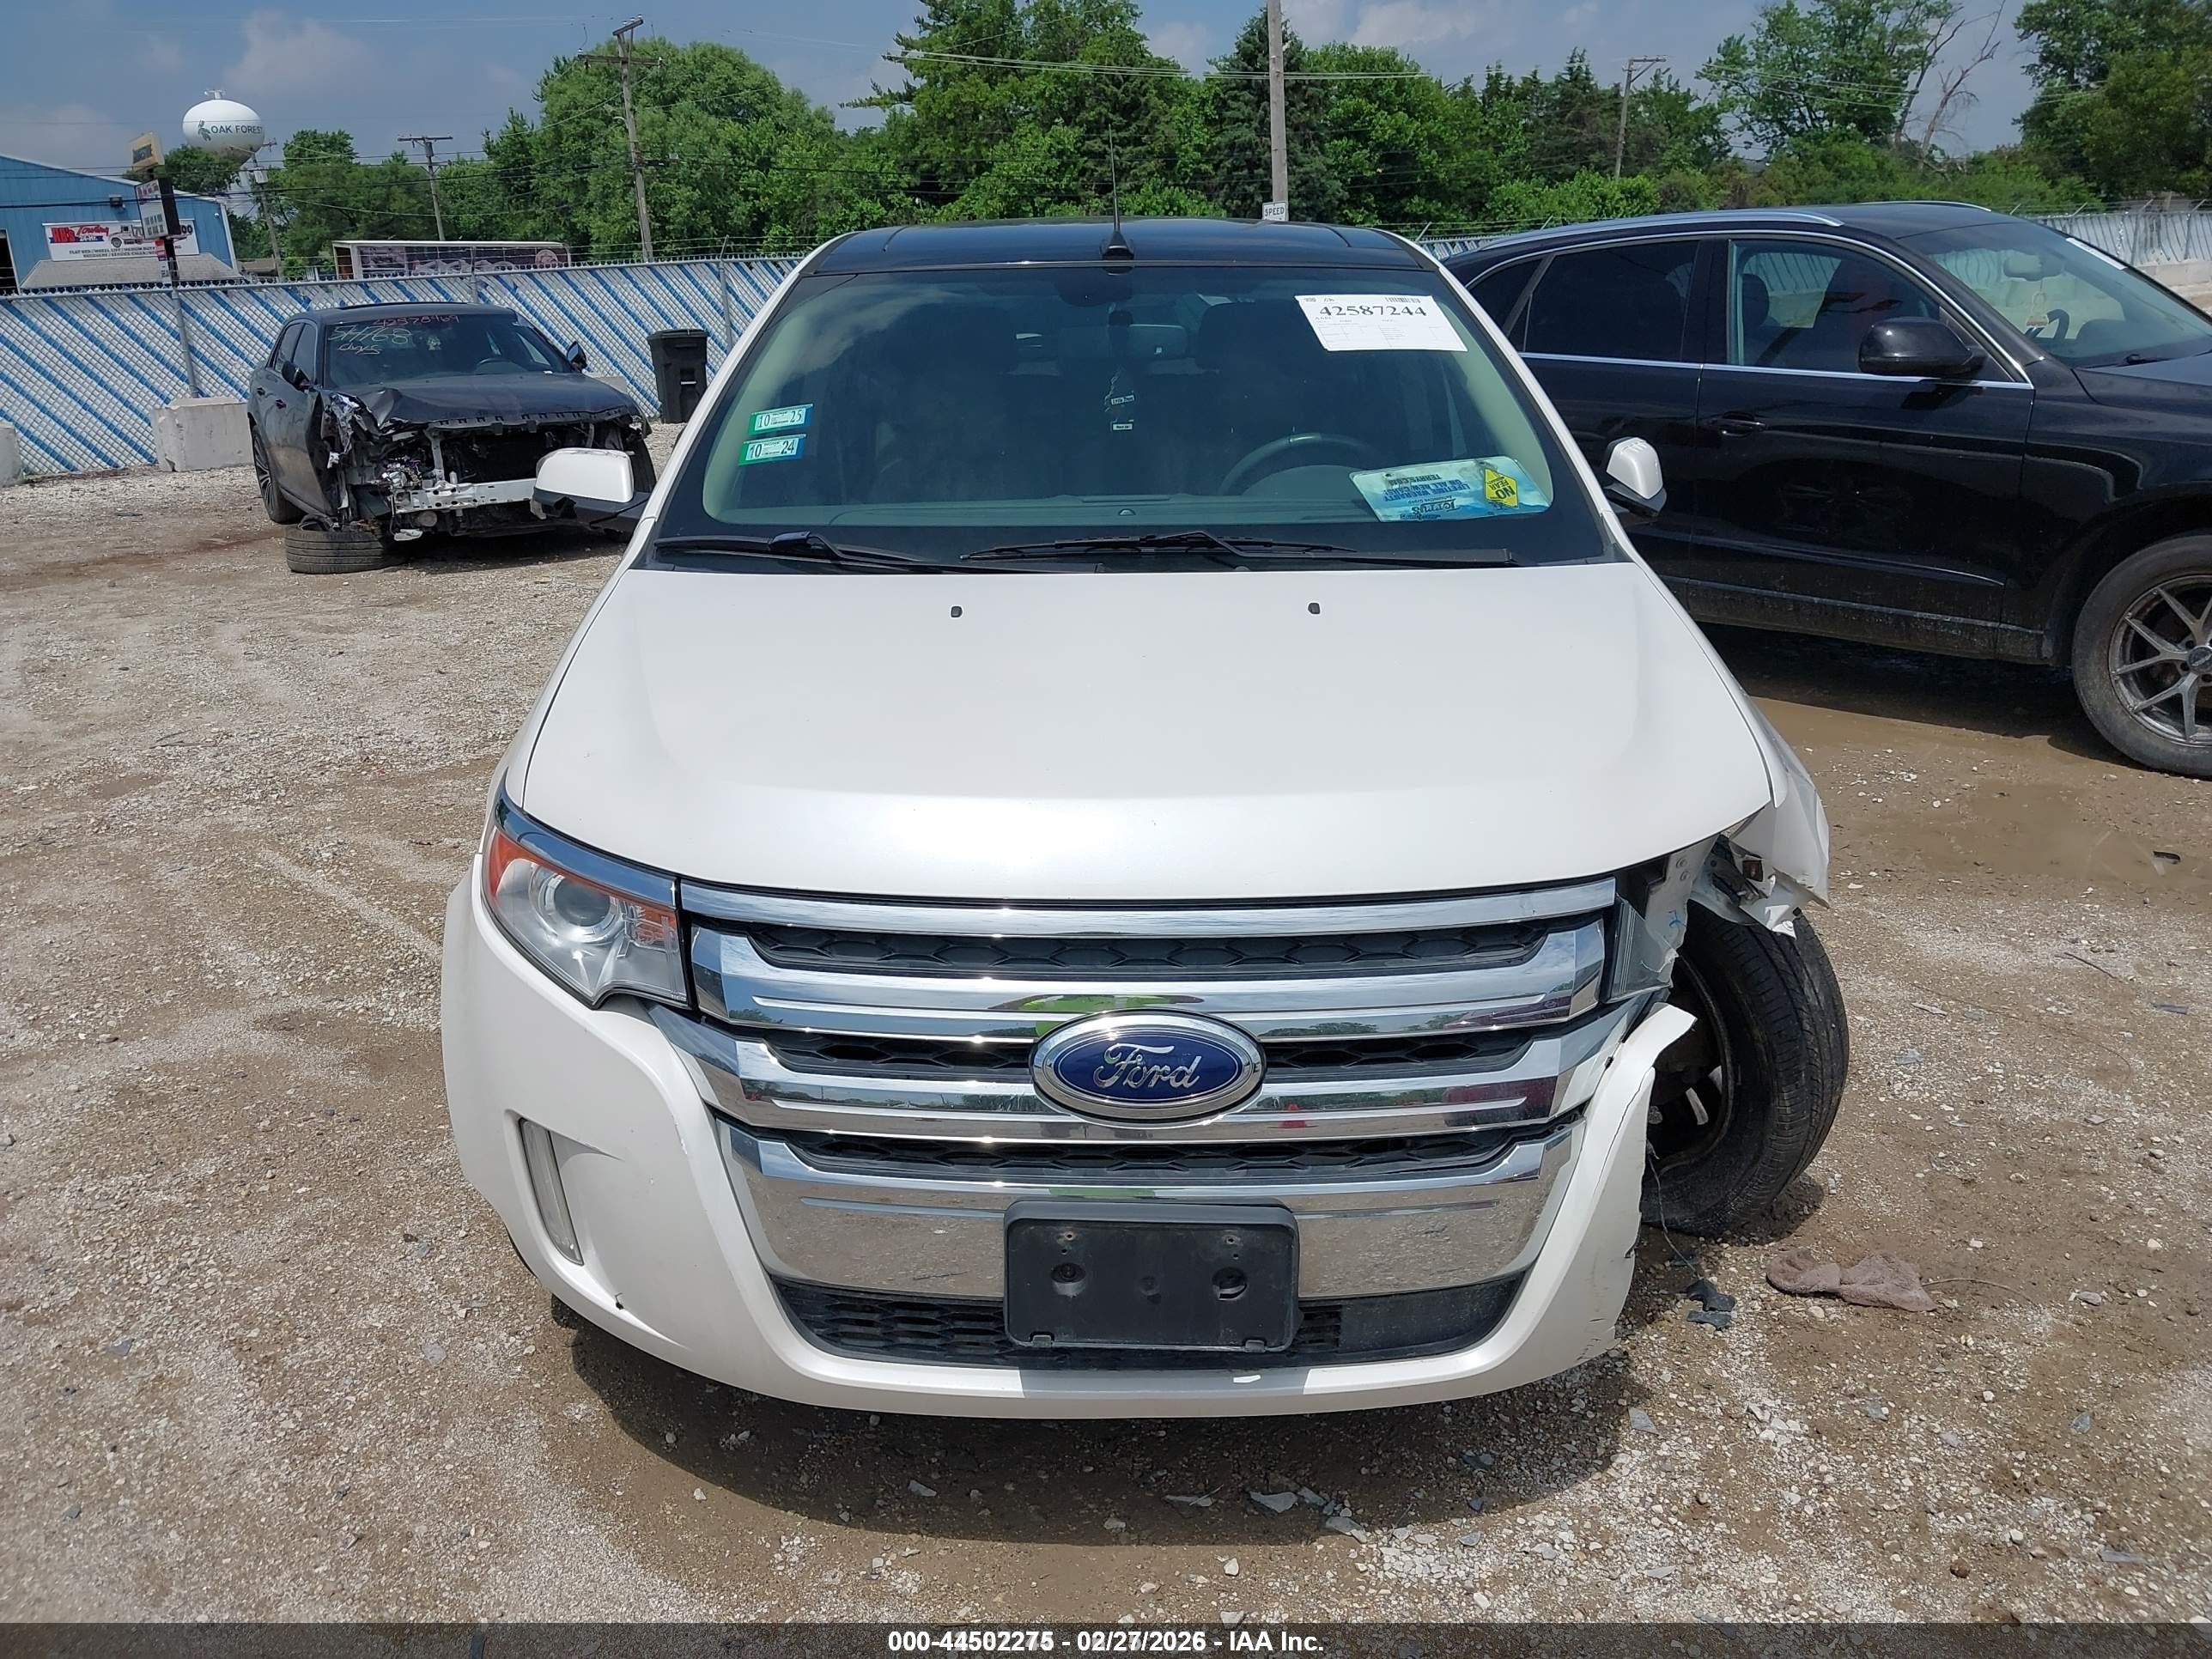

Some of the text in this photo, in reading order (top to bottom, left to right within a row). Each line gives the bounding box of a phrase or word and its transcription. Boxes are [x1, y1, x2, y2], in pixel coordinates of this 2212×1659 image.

[211, 125, 233, 134] OAK
[1265, 208, 1285, 216] SPEED
[1319, 306, 1427, 317] 42587244
[758, 414, 771, 428] 10
[789, 409, 803, 423] 25
[750, 443, 763, 459] 10
[781, 439, 795, 455] 24
[1489, 479, 1509, 490] FEAR
[1495, 485, 1516, 499] NO
[1093, 1042, 1202, 1089] Ford
